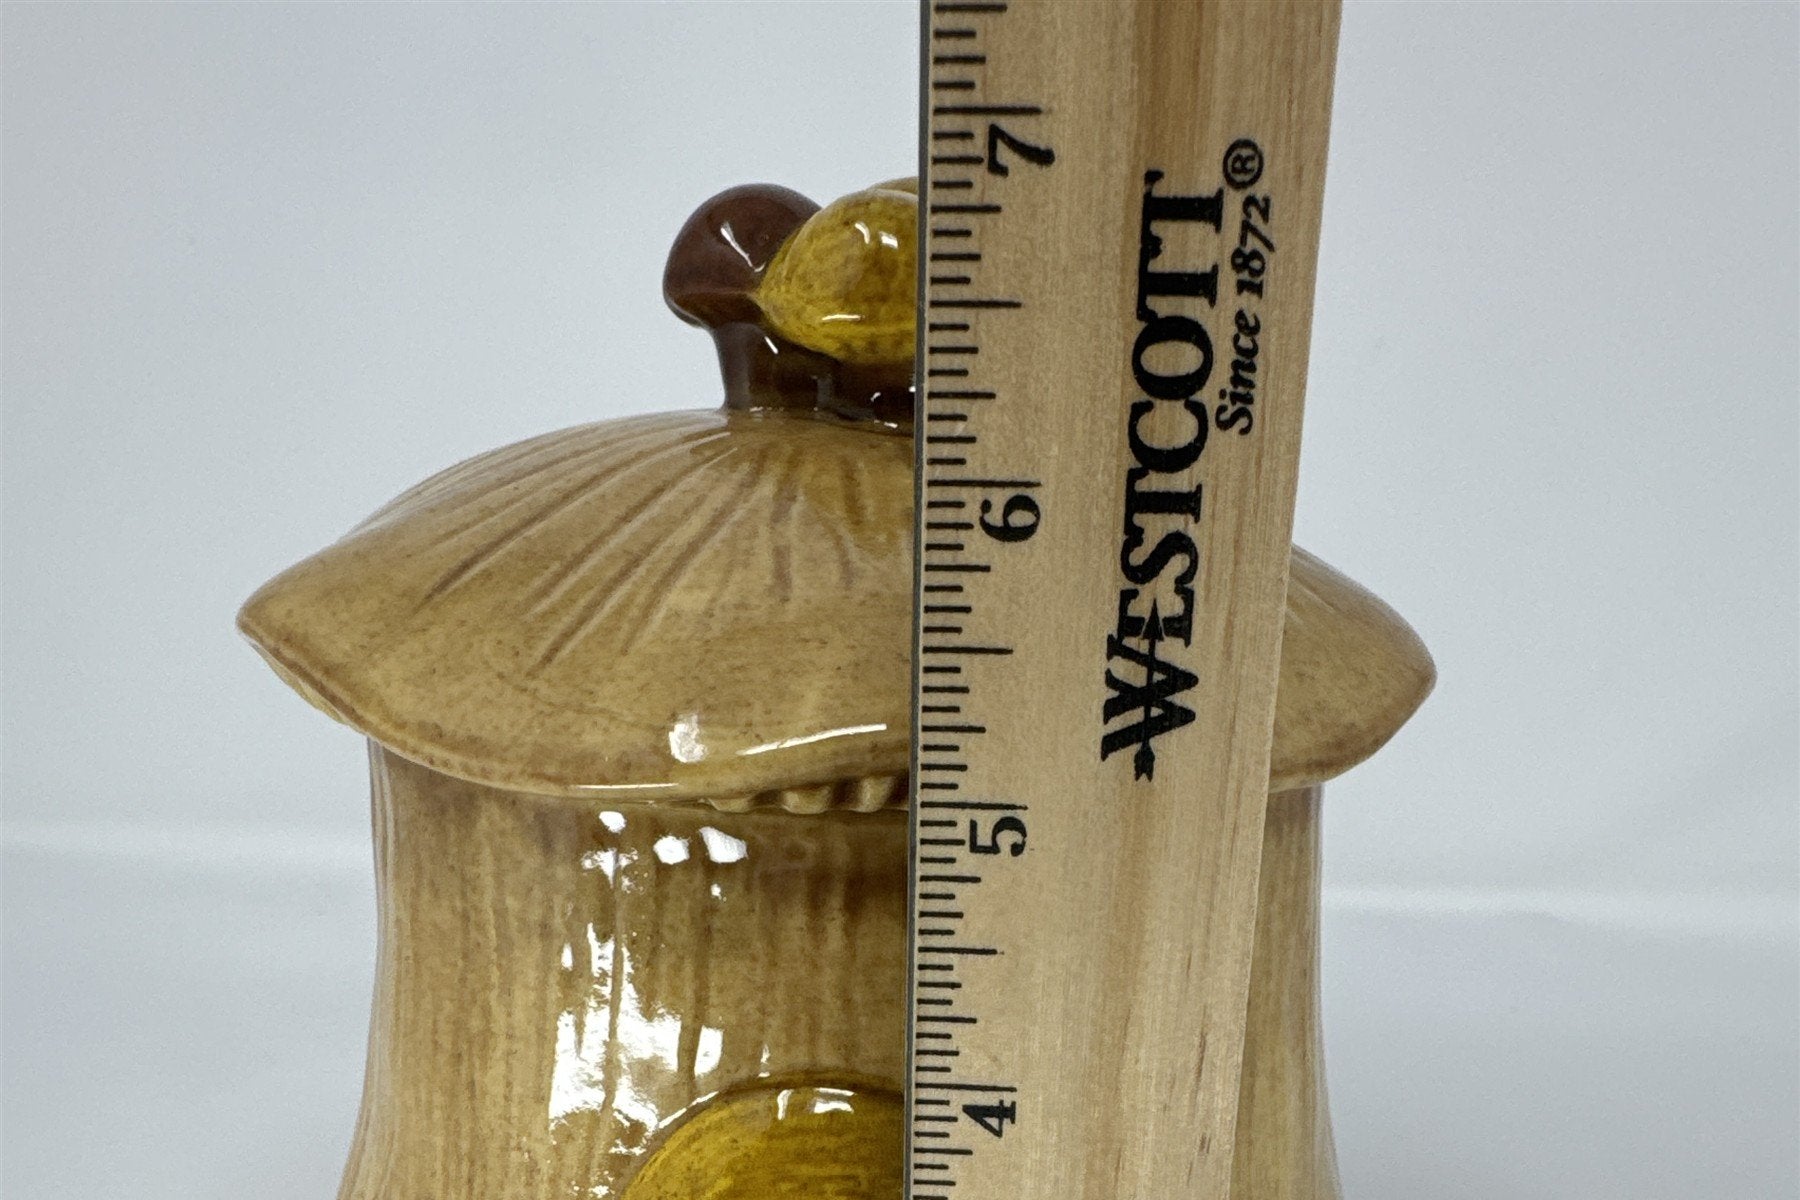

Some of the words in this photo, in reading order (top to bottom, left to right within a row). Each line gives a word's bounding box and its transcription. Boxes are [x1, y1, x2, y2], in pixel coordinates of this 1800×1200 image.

[986, 122, 1055, 178] 7
[1230, 193, 1275, 300] 1872
[1214, 308, 1262, 436] Since
[978, 493, 1041, 543] 6
[969, 816, 1028, 857] 5
[962, 1099, 1016, 1138] 4
